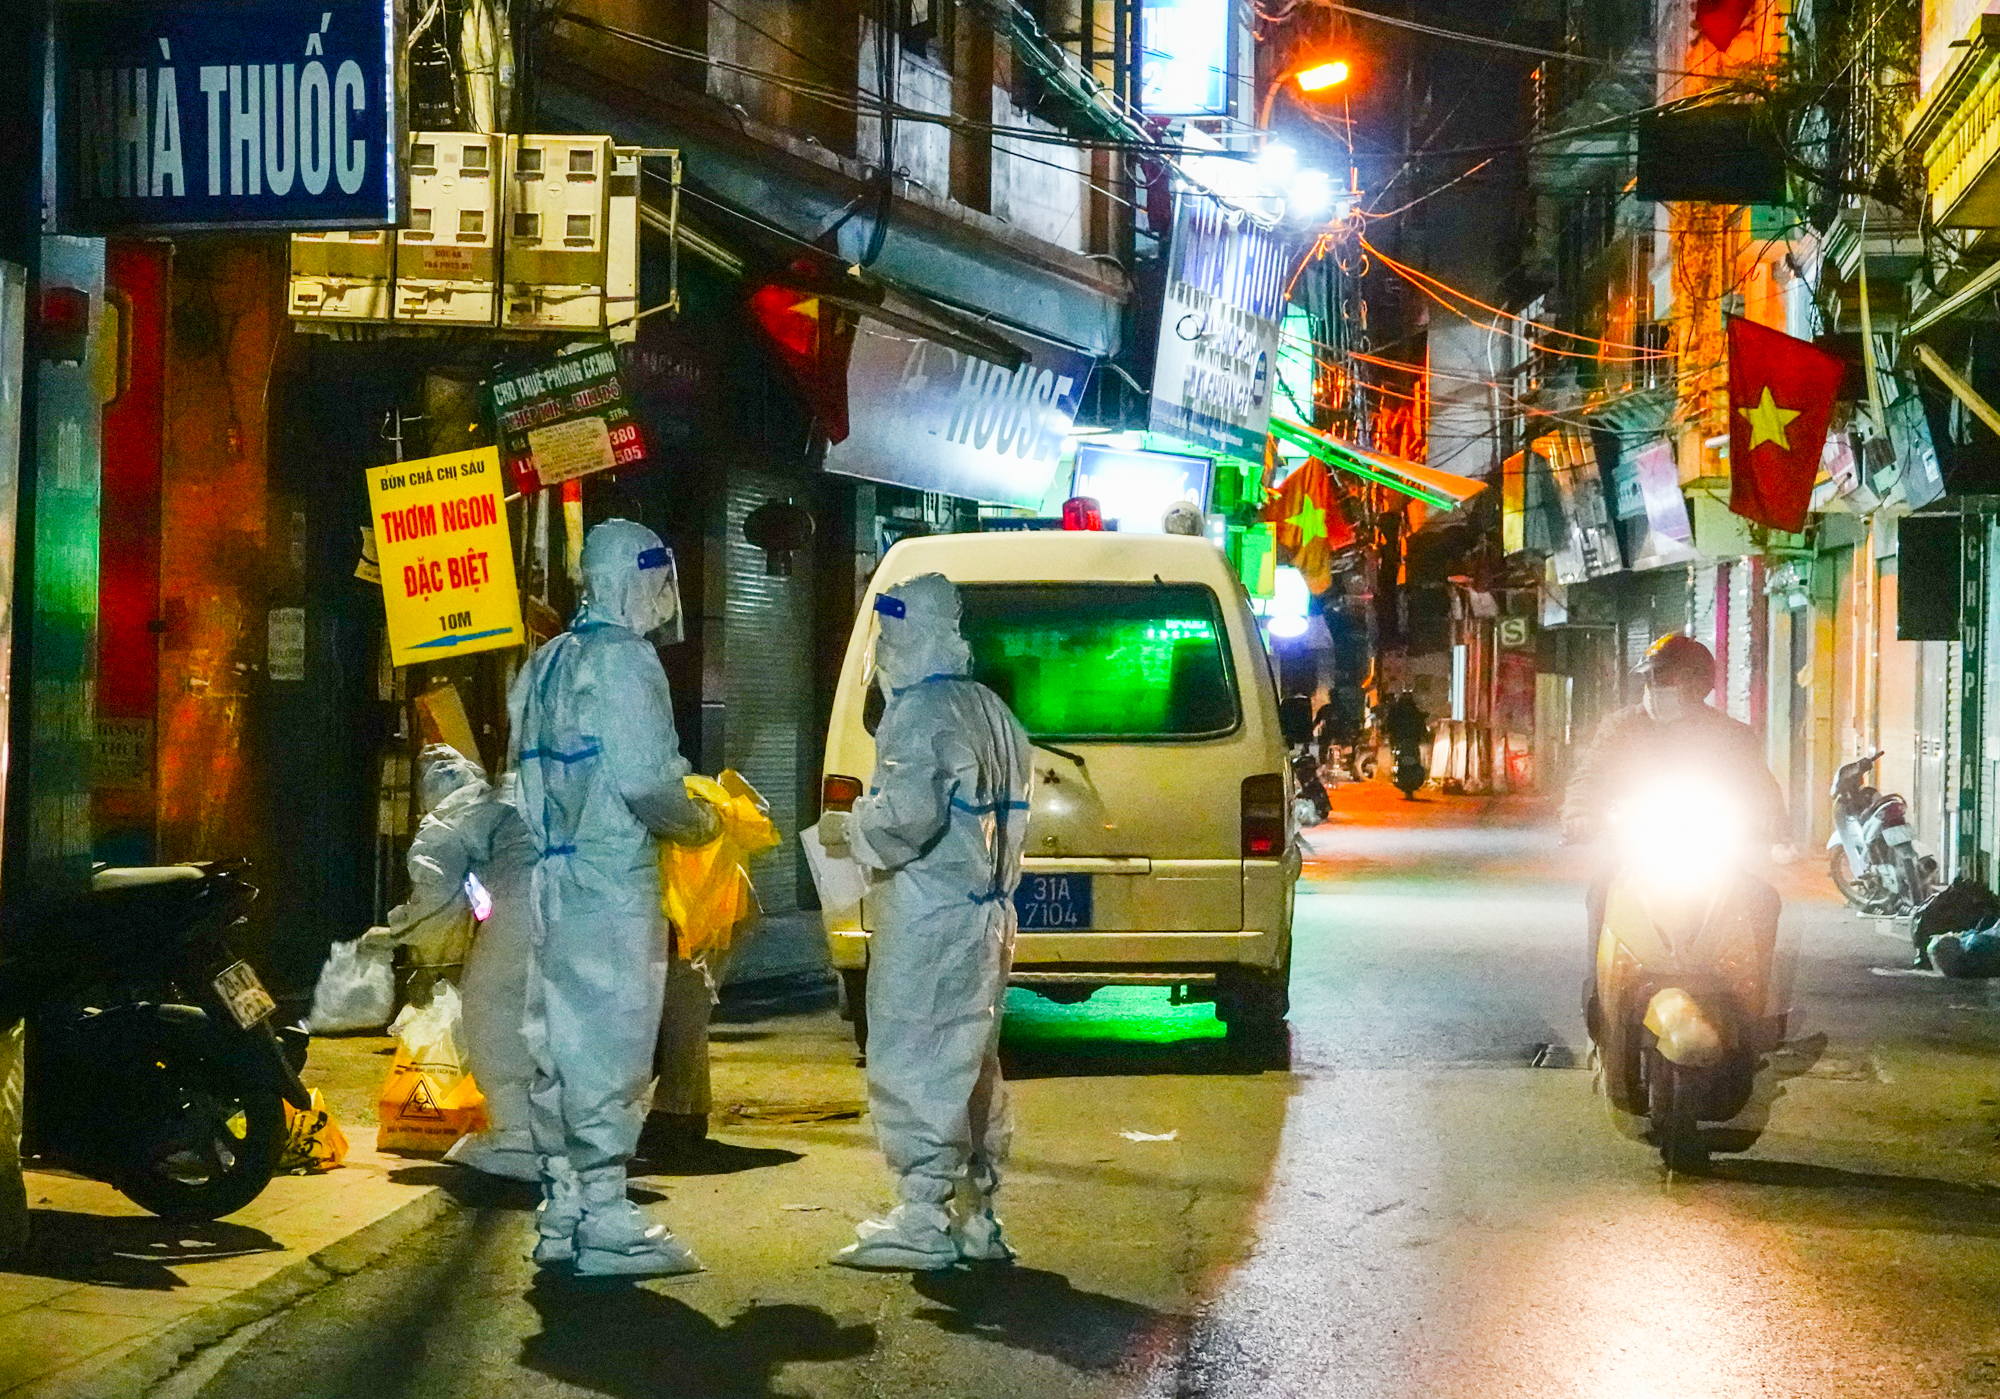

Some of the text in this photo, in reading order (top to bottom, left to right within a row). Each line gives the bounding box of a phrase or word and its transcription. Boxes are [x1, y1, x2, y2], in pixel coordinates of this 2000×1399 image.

[80, 12, 366, 198] NHÀ THUỐC
[493, 380, 518, 406] CHO
[543, 362, 583, 391] PHÒNG
[582, 351, 617, 379] CCMN
[946, 355, 1074, 461] HOUSE
[609, 425, 636, 446] 380
[616, 445, 642, 465] 505
[381, 460, 486, 491] BÚN CHẢ CHỊ SÁU
[381, 493, 498, 544] THƠM NGON
[403, 547, 490, 602] ĐẶC BIỆT
[439, 611, 473, 631] 10M
[1034, 877, 1071, 901] 31A
[1025, 902, 1078, 927] 7104
